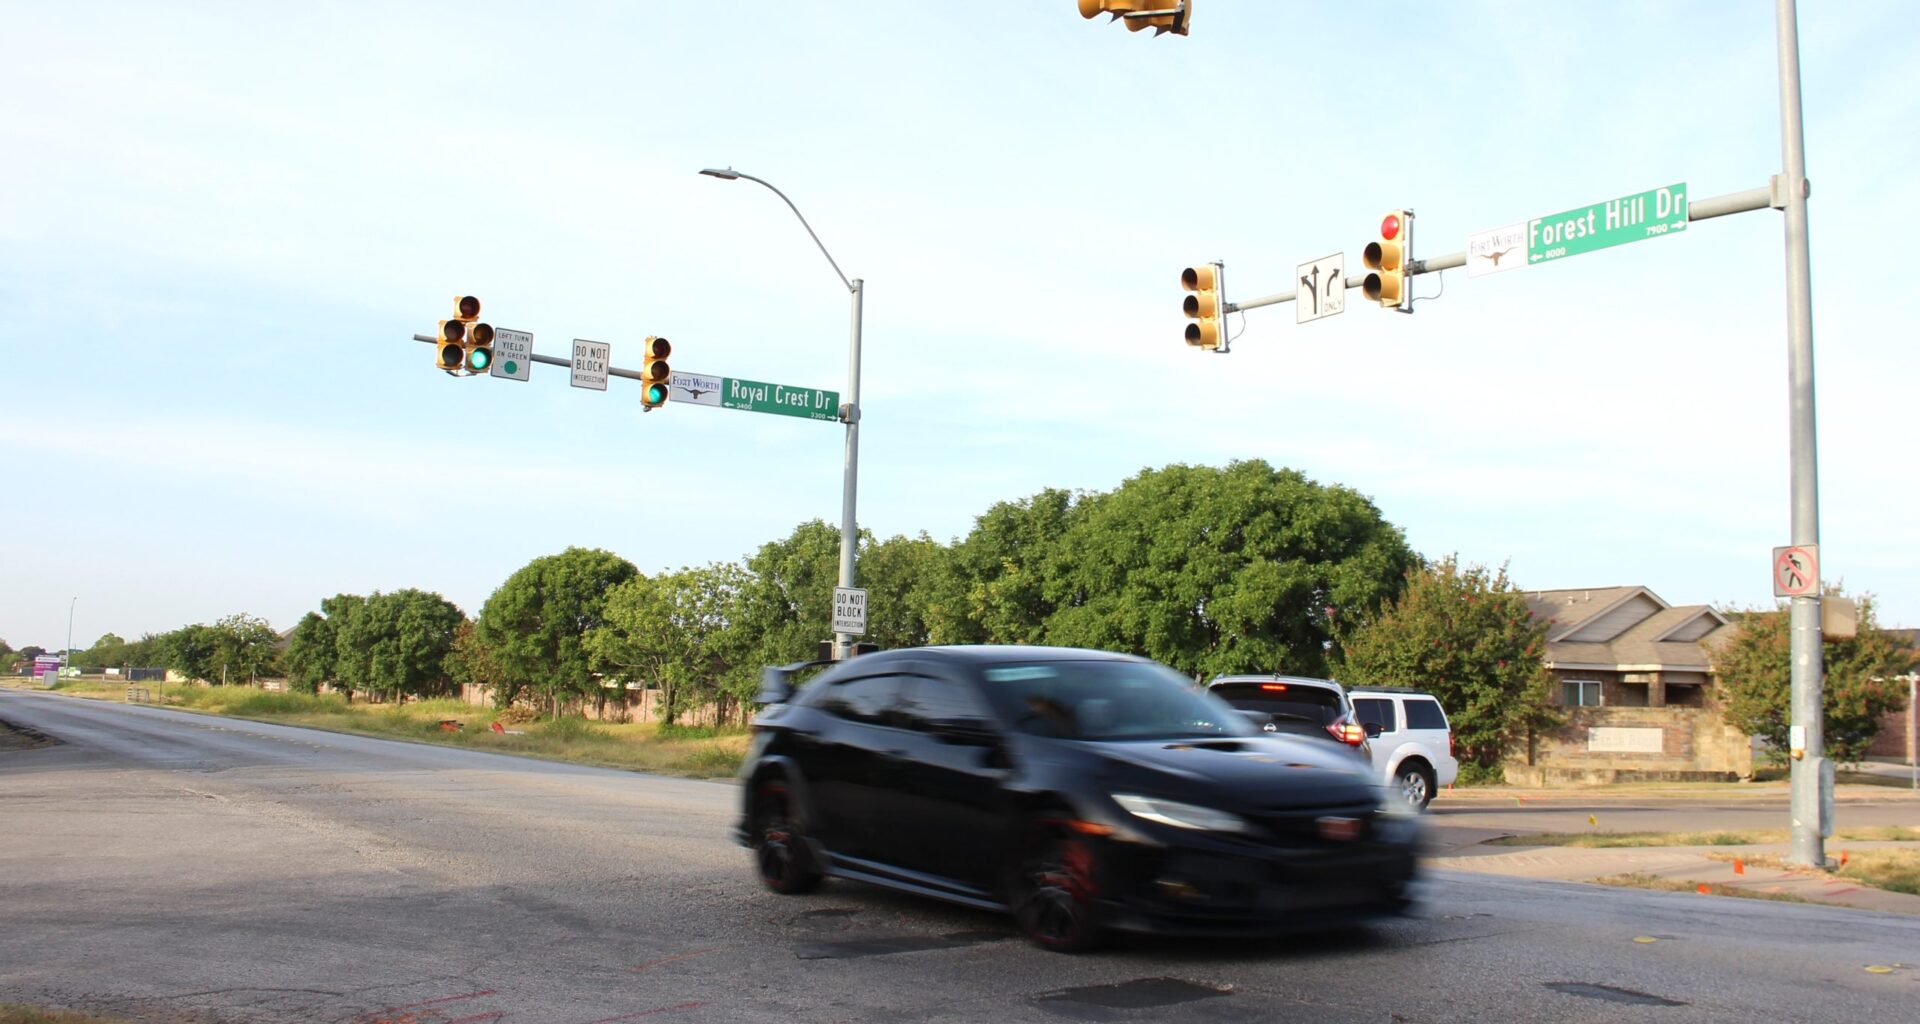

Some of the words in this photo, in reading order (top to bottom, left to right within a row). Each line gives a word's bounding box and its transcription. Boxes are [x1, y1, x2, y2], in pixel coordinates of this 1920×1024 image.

[1529, 209, 1596, 249] Forest
[1606, 196, 1644, 231] Hill
[1656, 188, 1684, 219] Dr
[1646, 224, 1668, 236] 7900
[1324, 300, 1343, 312] ONLY
[498, 332, 512, 340] LEFT
[503, 341, 524, 352] YIELD
[508, 353, 528, 361] GREEN
[576, 346, 586, 357] DO
[590, 348, 607, 360] NOT
[576, 359, 604, 372] BLOCK
[731, 380, 768, 404] Royal
[775, 385, 809, 407] Crest
[815, 391, 830, 410] Dr
[837, 593, 846, 604] DO
[850, 595, 864, 605] NOT
[838, 606, 861, 618] BLOCK
